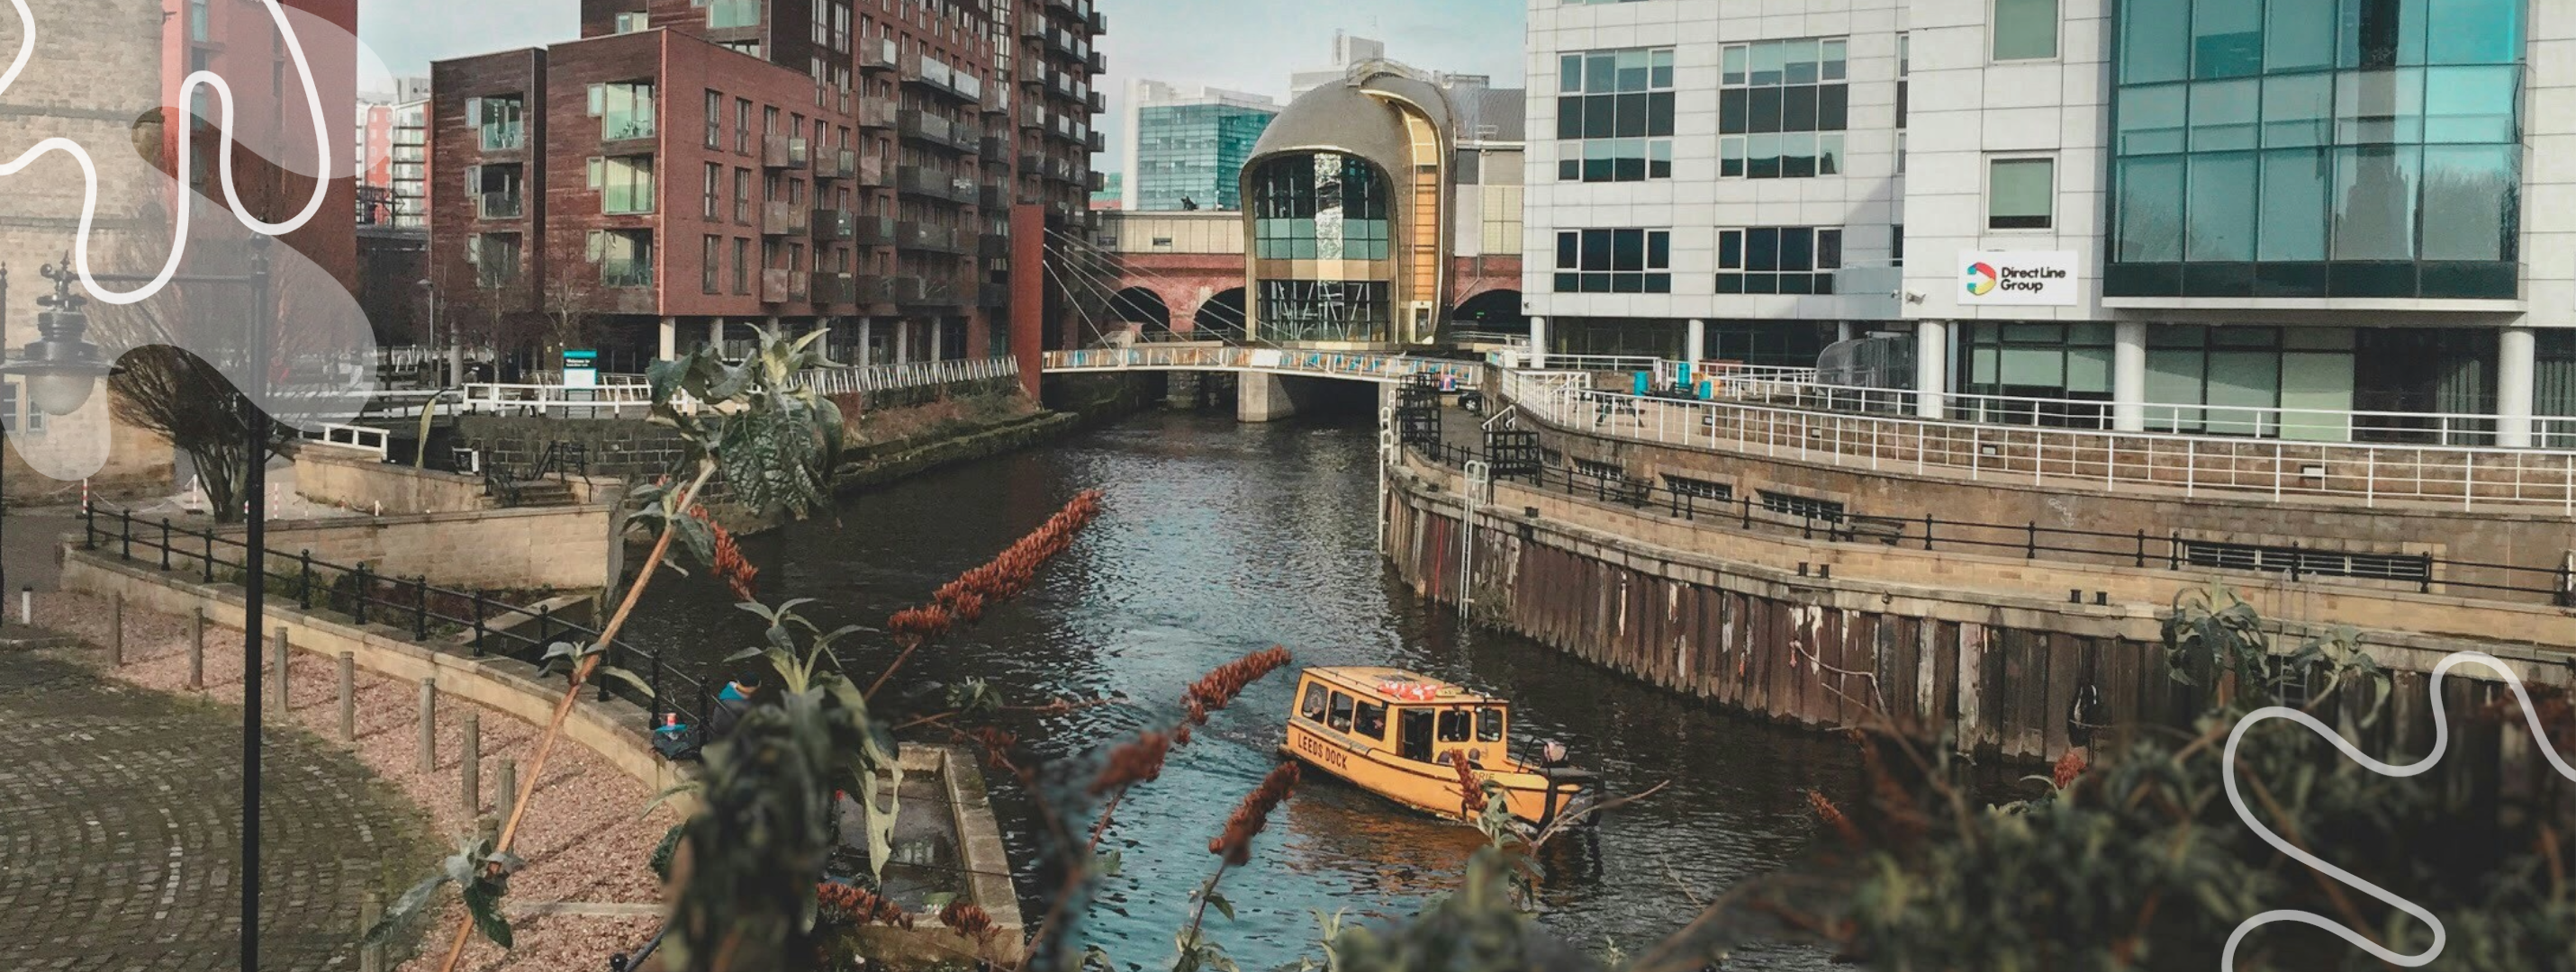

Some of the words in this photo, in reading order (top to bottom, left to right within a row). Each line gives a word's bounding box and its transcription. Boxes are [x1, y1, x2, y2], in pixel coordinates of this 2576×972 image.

[2001, 266, 2039, 279] Direct
[2040, 266, 2066, 279] Line
[2001, 279, 2044, 293] Group
[1297, 733, 1324, 759] LEEDS
[1325, 746, 1349, 771] DOCK
